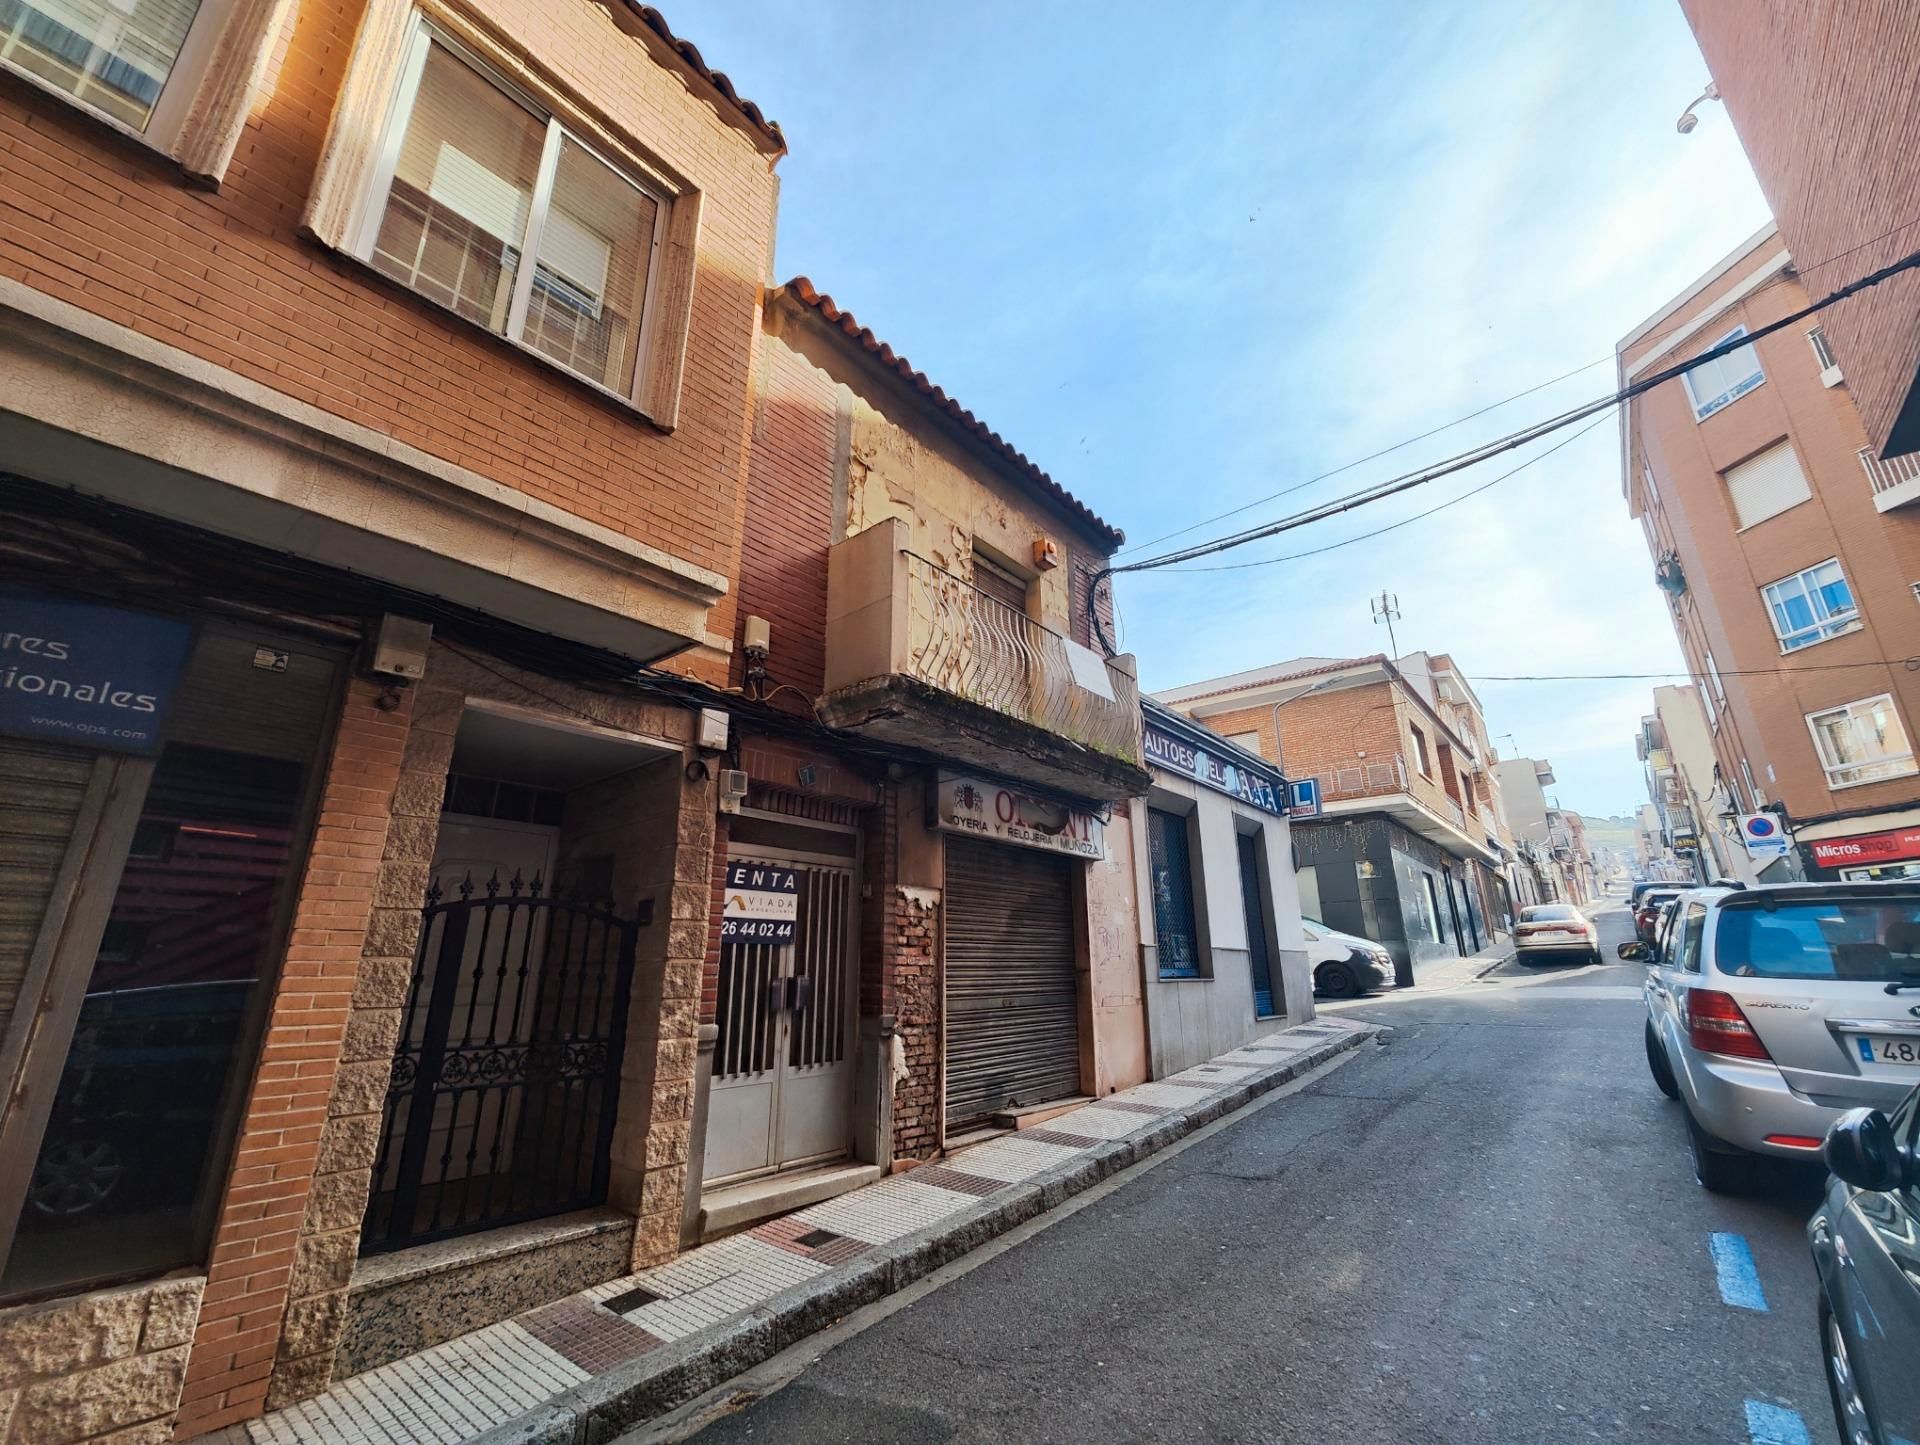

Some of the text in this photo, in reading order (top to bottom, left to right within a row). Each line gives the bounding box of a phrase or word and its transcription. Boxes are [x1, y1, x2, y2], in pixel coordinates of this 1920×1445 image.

[0, 632, 70, 660] res
[0, 666, 157, 713] ionales
[31, 715, 147, 740] www.opscom
[951, 815, 988, 832] OYERIA
[1007, 827, 1053, 845] RELOJERIA
[726, 867, 795, 889] ENTA
[748, 896, 794, 908] VIADA
[740, 922, 757, 936] 44
[759, 923, 775, 937] 02
[776, 924, 792, 938] 44
[1883, 1042, 1920, 1063] 48
